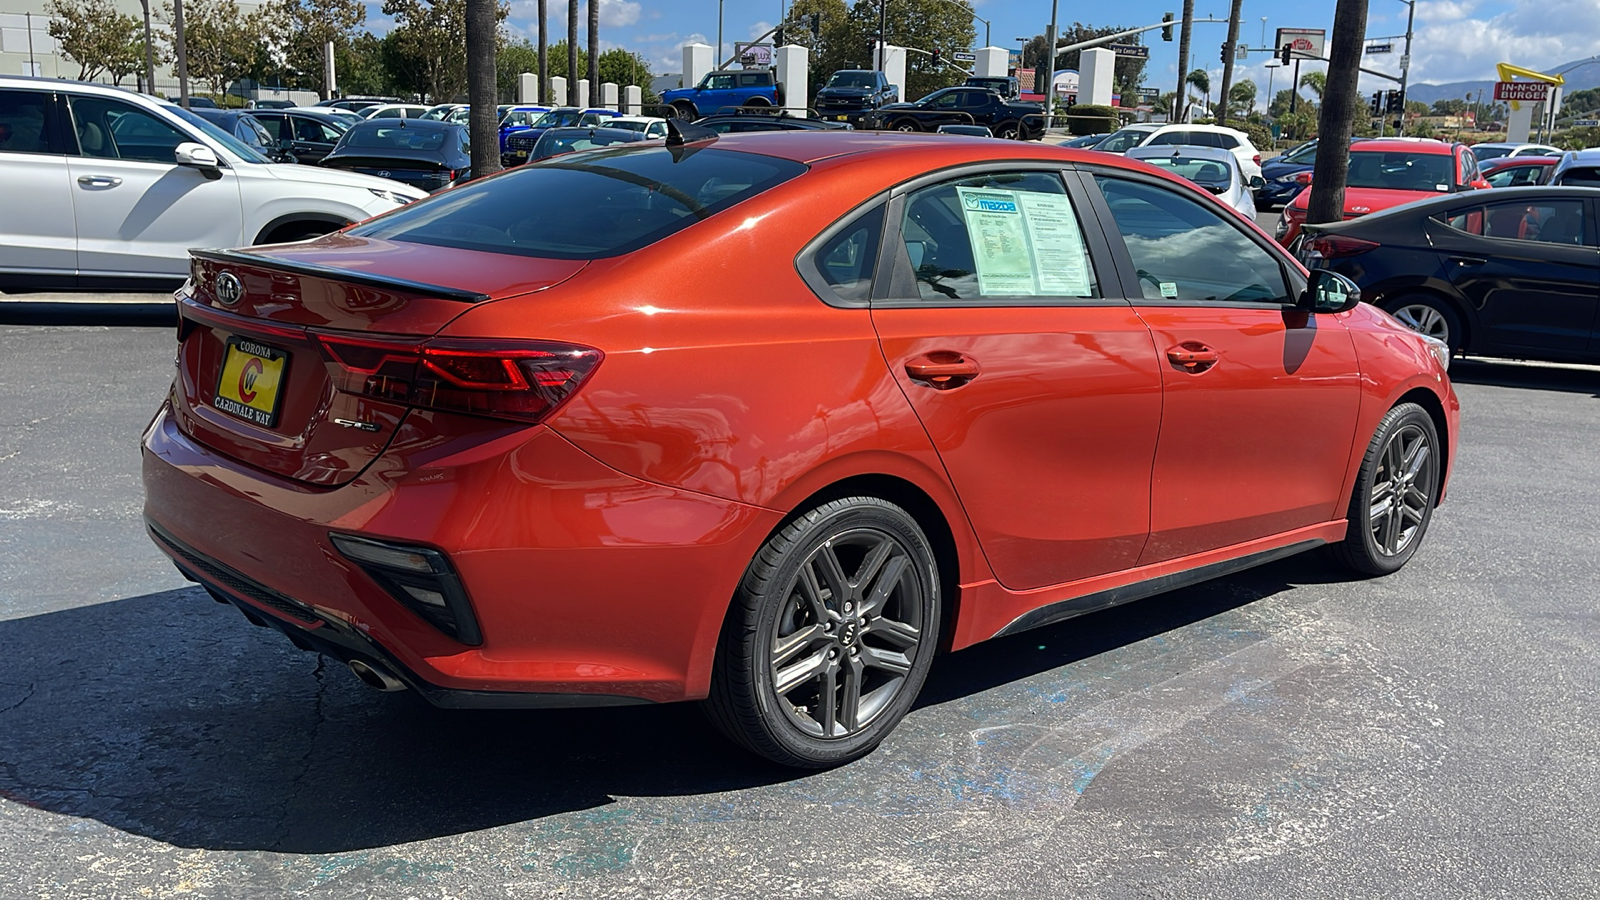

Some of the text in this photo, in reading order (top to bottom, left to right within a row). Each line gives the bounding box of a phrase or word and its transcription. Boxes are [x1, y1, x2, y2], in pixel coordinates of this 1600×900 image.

[1501, 91, 1547, 99] BURGER
[980, 200, 1017, 211] mazda
[240, 341, 271, 358] CORONA
[245, 372, 257, 391] W
[214, 396, 271, 426] CARDINALE WAY
[842, 623, 855, 645] KIA
